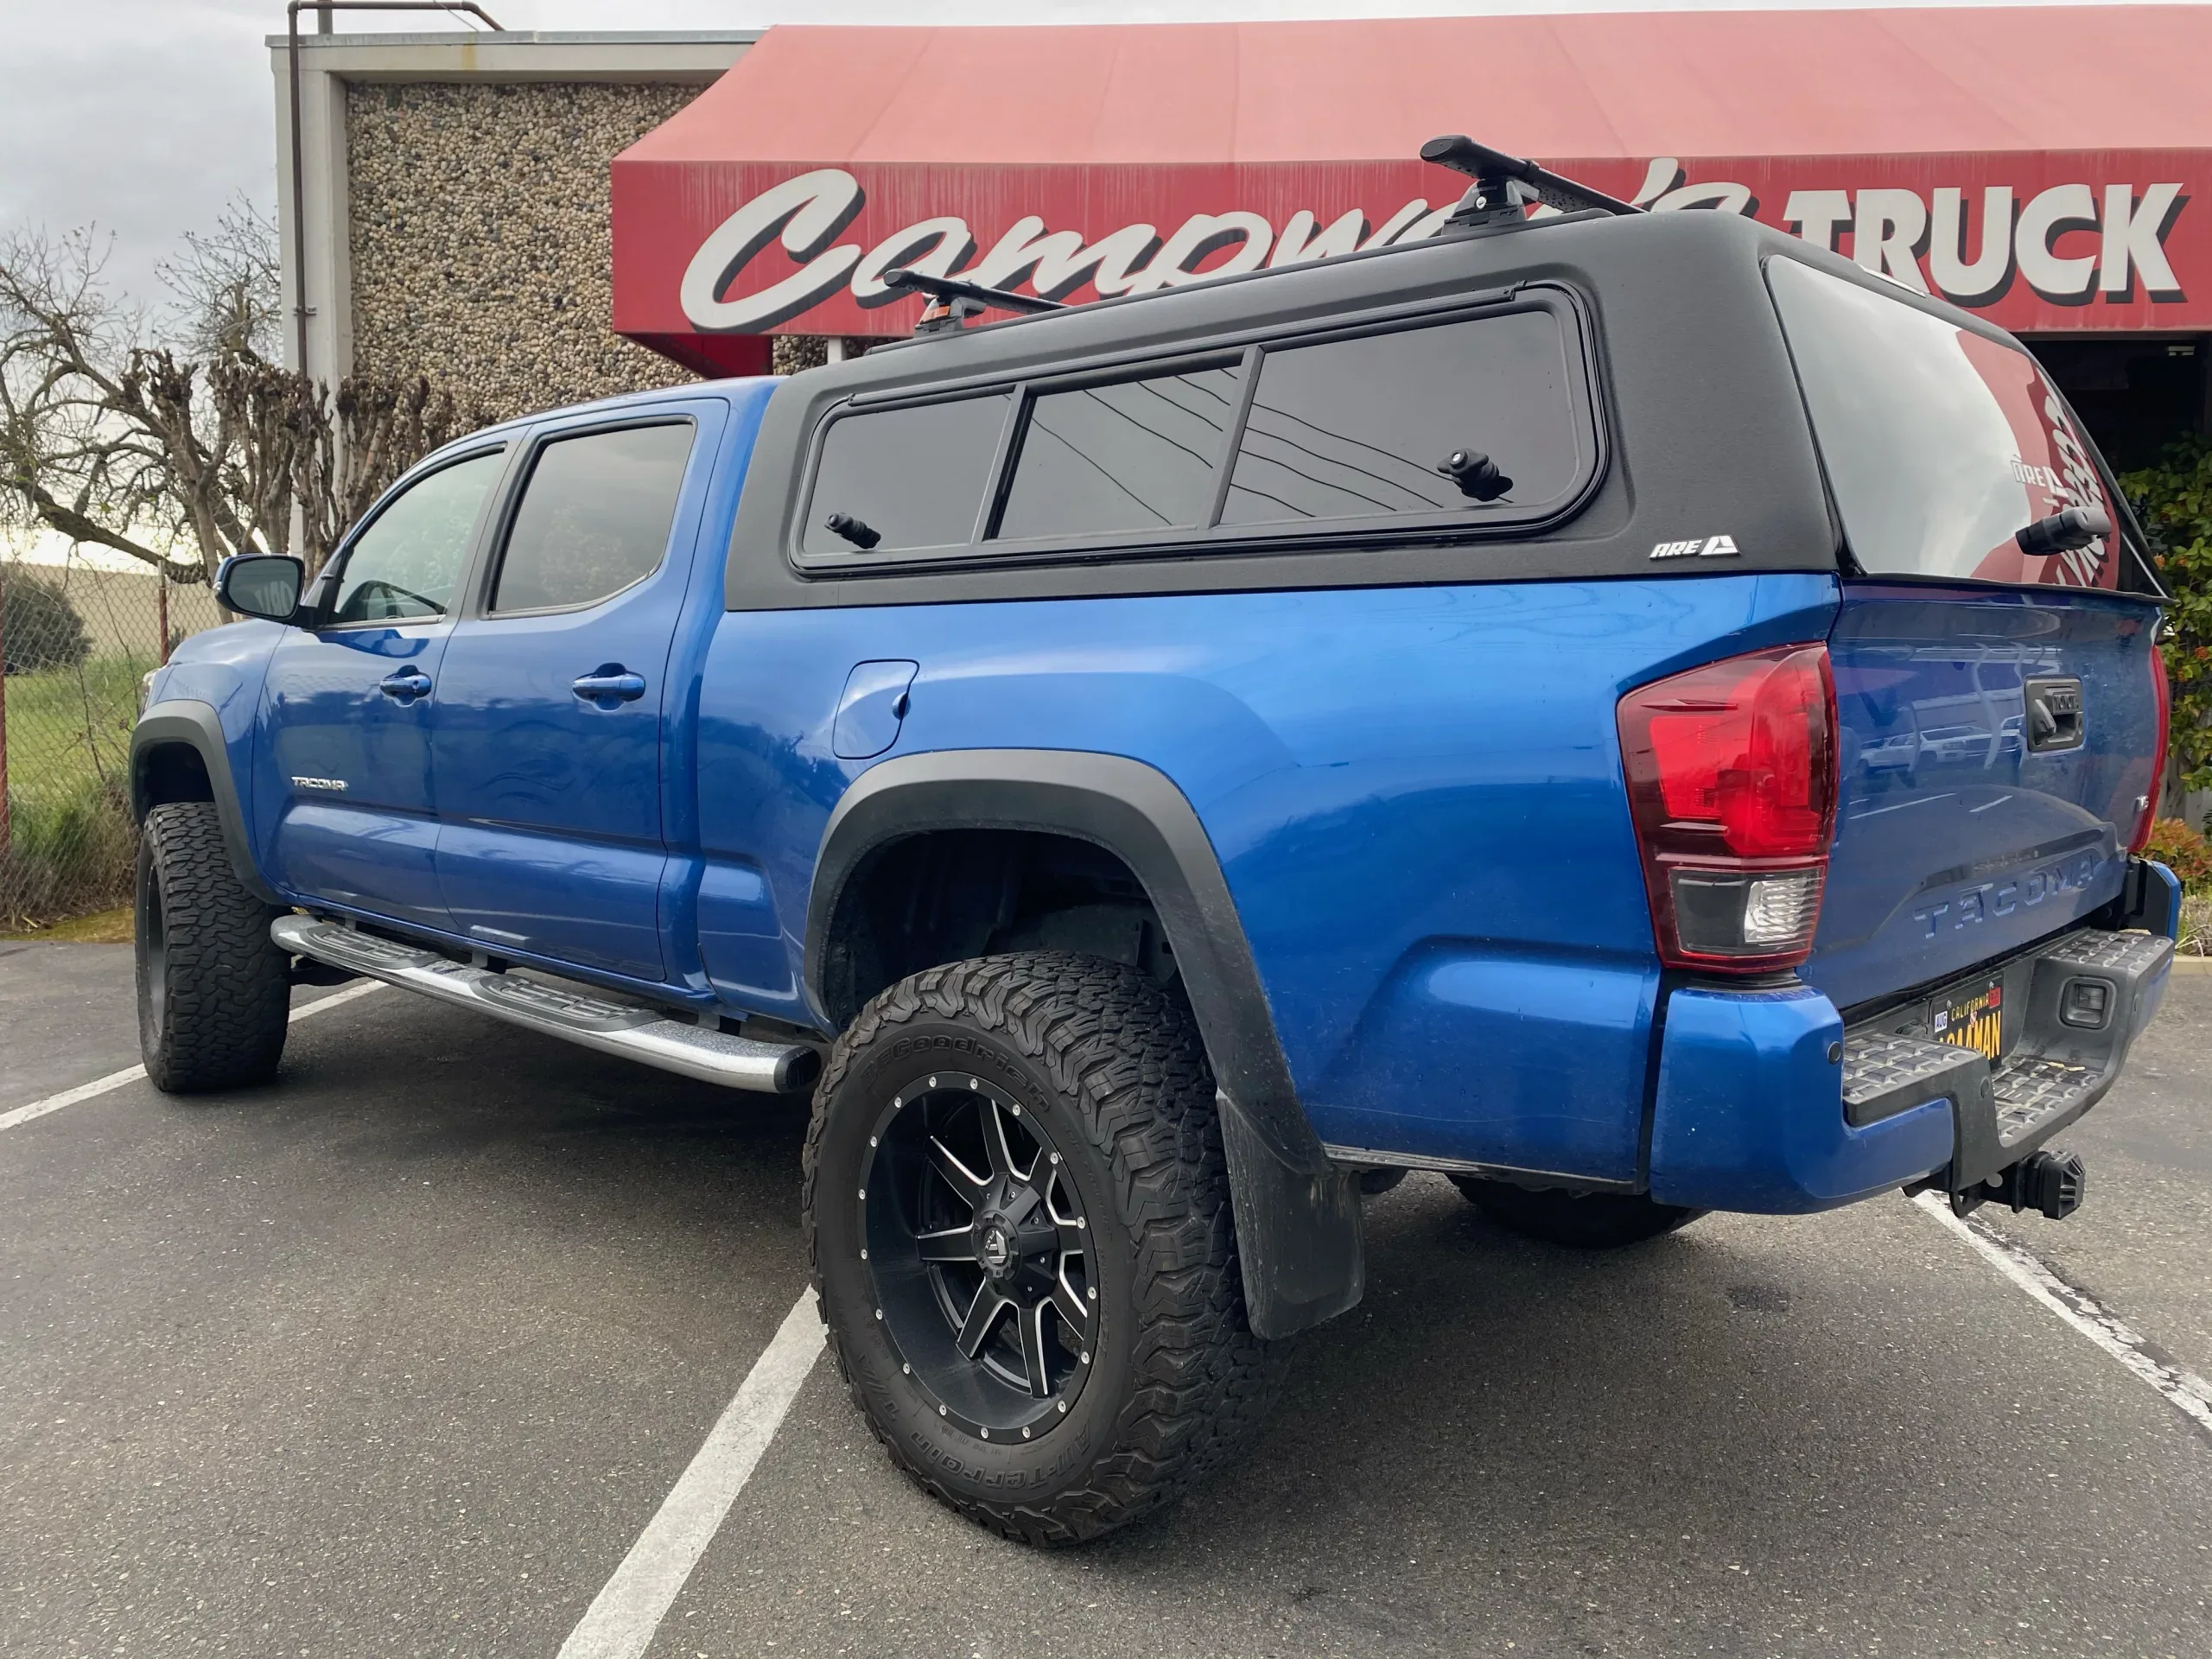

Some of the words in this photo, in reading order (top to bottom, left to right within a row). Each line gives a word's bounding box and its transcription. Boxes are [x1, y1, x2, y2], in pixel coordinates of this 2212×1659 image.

[1783, 183, 2183, 297] TRUCK
[1649, 539, 1703, 559] ARE
[290, 776, 349, 791] TACOMA
[1912, 855, 2096, 939] TACOMA
[1951, 993, 1990, 1022] CALIFORNIA
[1936, 1012, 1948, 1030] AUG
